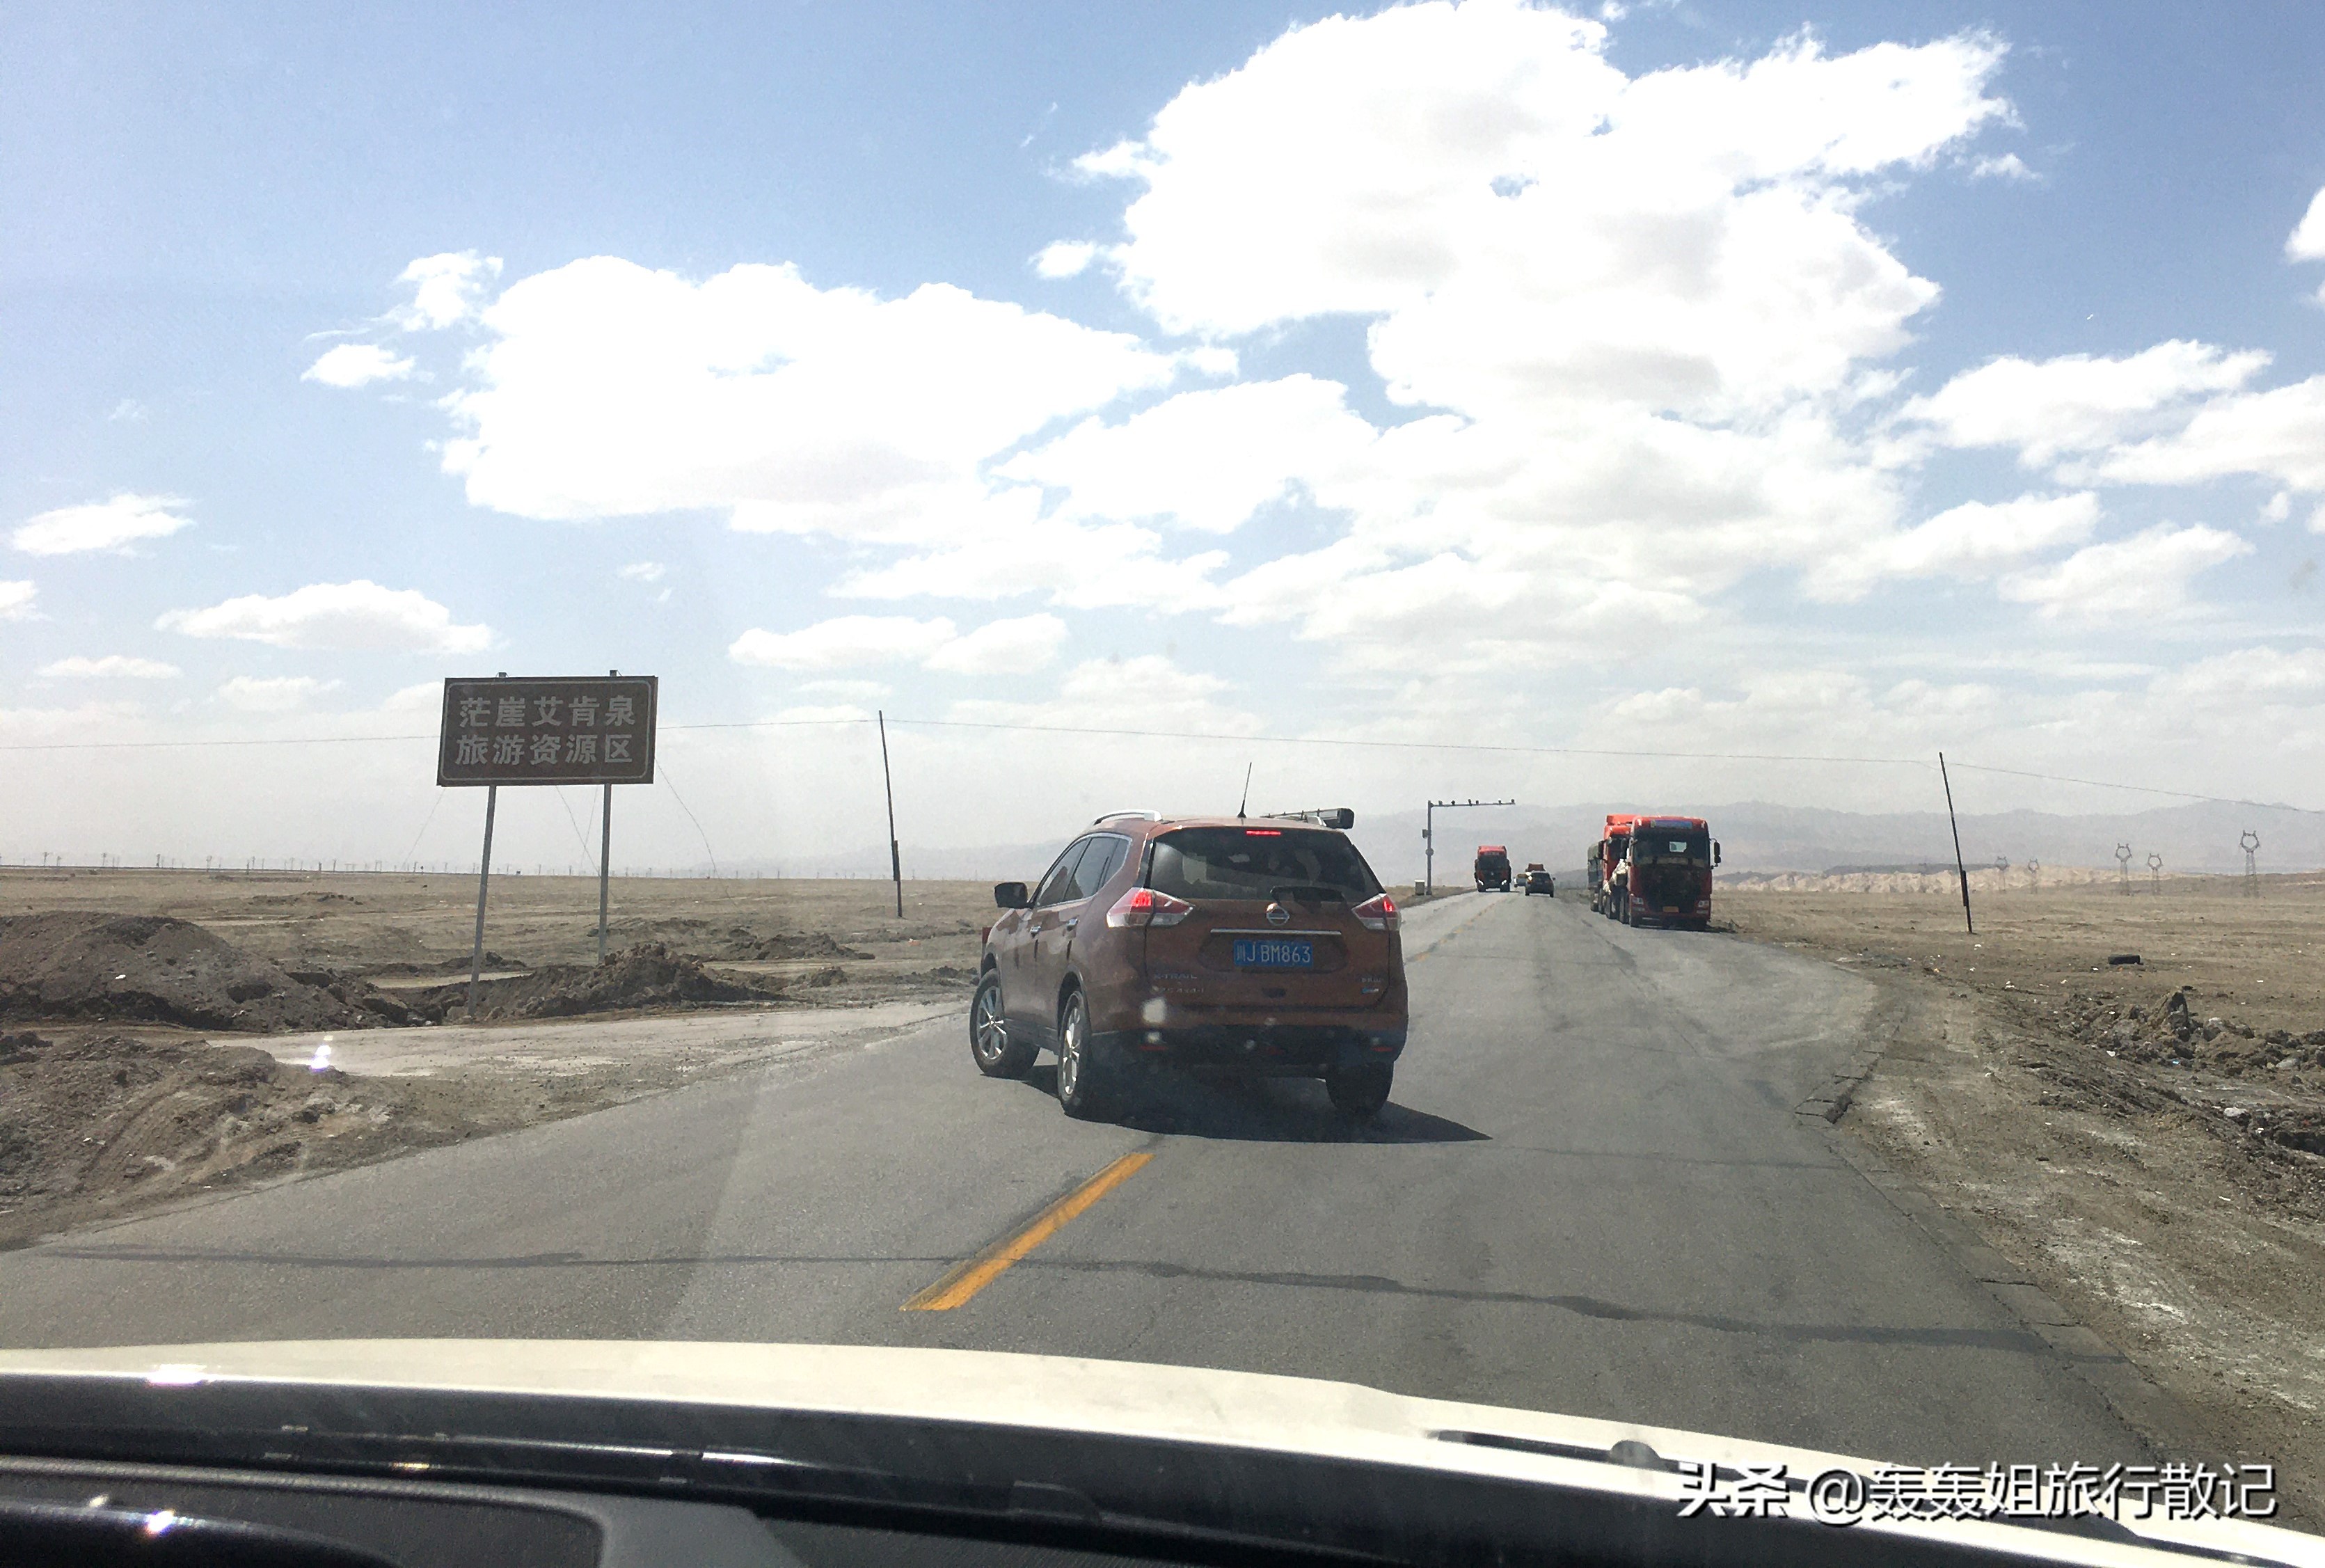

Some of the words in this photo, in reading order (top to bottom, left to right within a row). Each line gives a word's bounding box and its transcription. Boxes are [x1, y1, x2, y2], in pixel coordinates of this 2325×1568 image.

[459, 696, 636, 728] 茫崖艾肯泉
[455, 734, 633, 766] 旅游资源区
